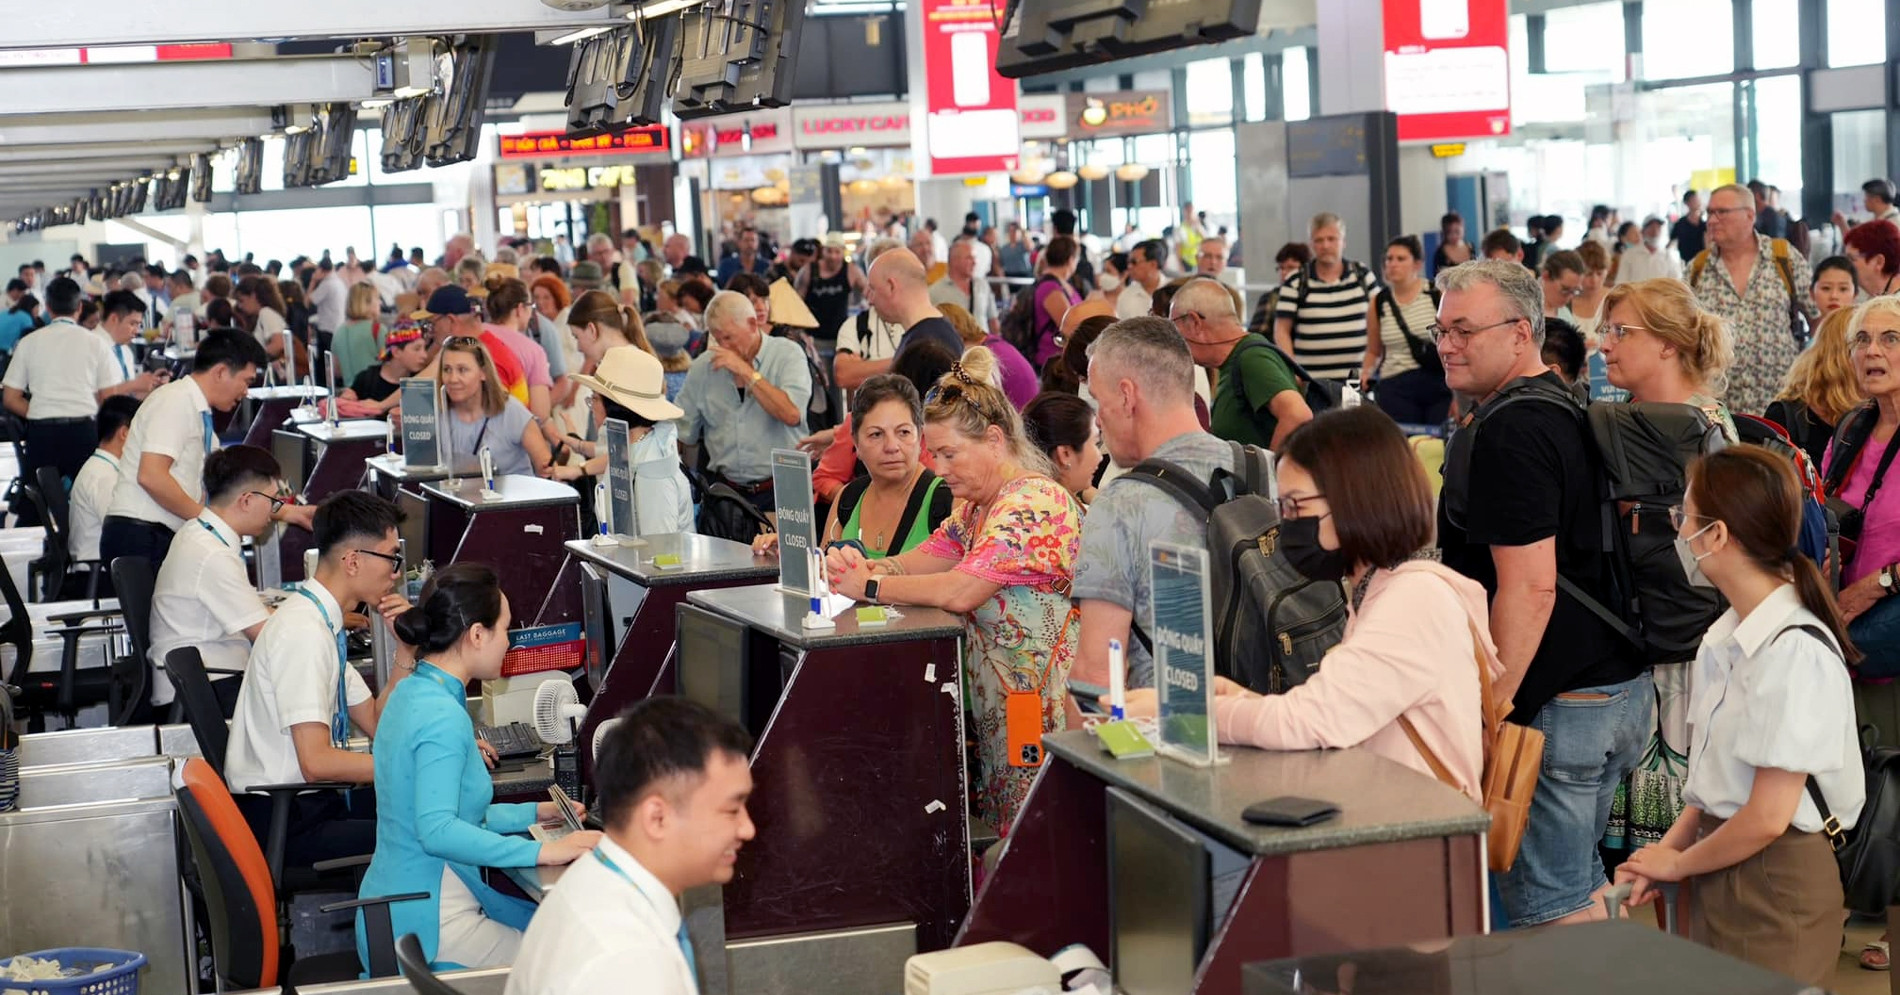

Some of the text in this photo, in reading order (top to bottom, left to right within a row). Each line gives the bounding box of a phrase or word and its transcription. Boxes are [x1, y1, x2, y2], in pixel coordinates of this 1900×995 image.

[803, 116, 867, 136] LUCKY
[409, 431, 431, 440] CLOSED
[784, 533, 807, 548] CLOSED
[515, 633, 531, 641] LAST
[532, 628, 567, 639] BAGGAGE
[1164, 665, 1198, 692] CLOSED
